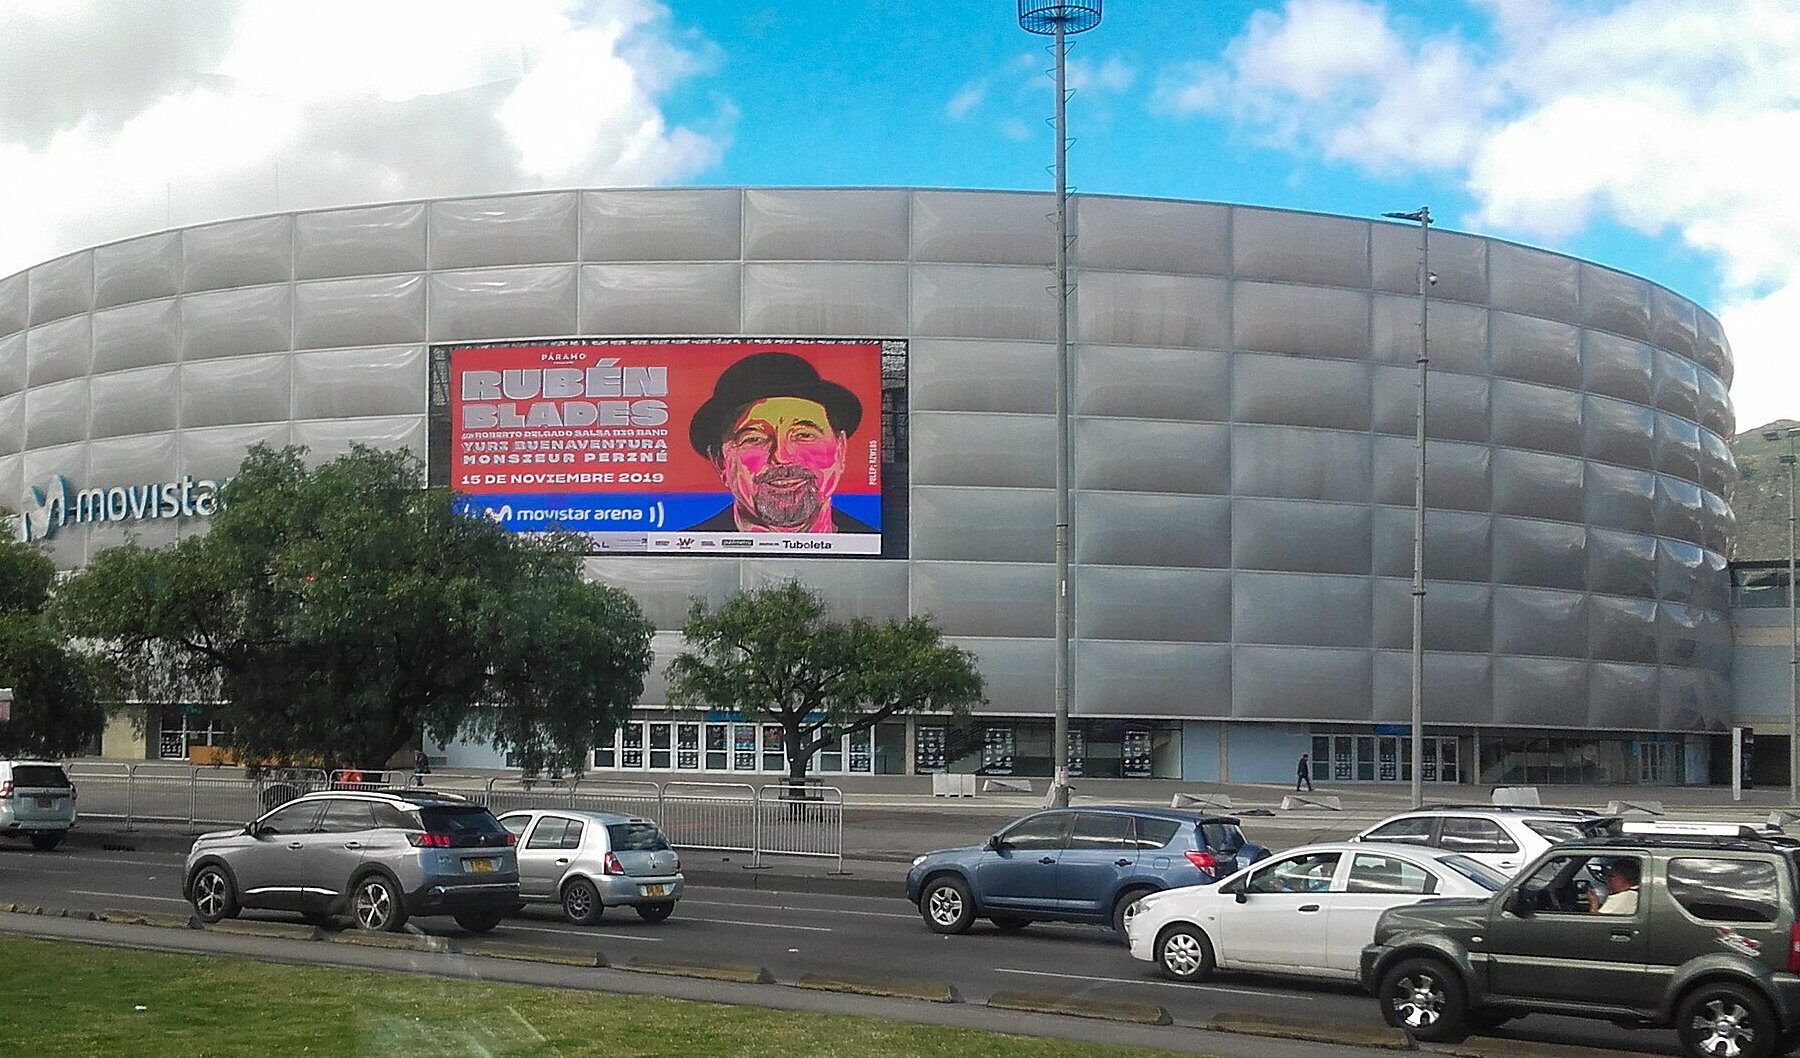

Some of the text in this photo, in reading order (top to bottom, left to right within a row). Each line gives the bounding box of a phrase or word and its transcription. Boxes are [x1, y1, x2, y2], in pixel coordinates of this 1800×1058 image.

[461, 358, 669, 400] RUBÉN
[461, 400, 669, 429] BLADES
[475, 431, 522, 439] ROBERTO
[524, 430, 573, 438] DELGADO
[575, 429, 611, 437] SALSA
[612, 429, 635, 437] BIG
[461, 439, 668, 452] YURI BUENAVENTURA
[462, 450, 668, 465] MONSIEUR PERINÉ
[461, 472, 664, 485] 15 DE NOVIEMBRE 2019
[516, 507, 592, 522] movistar
[594, 508, 643, 521] arena
[782, 540, 832, 549] Tuboleta
